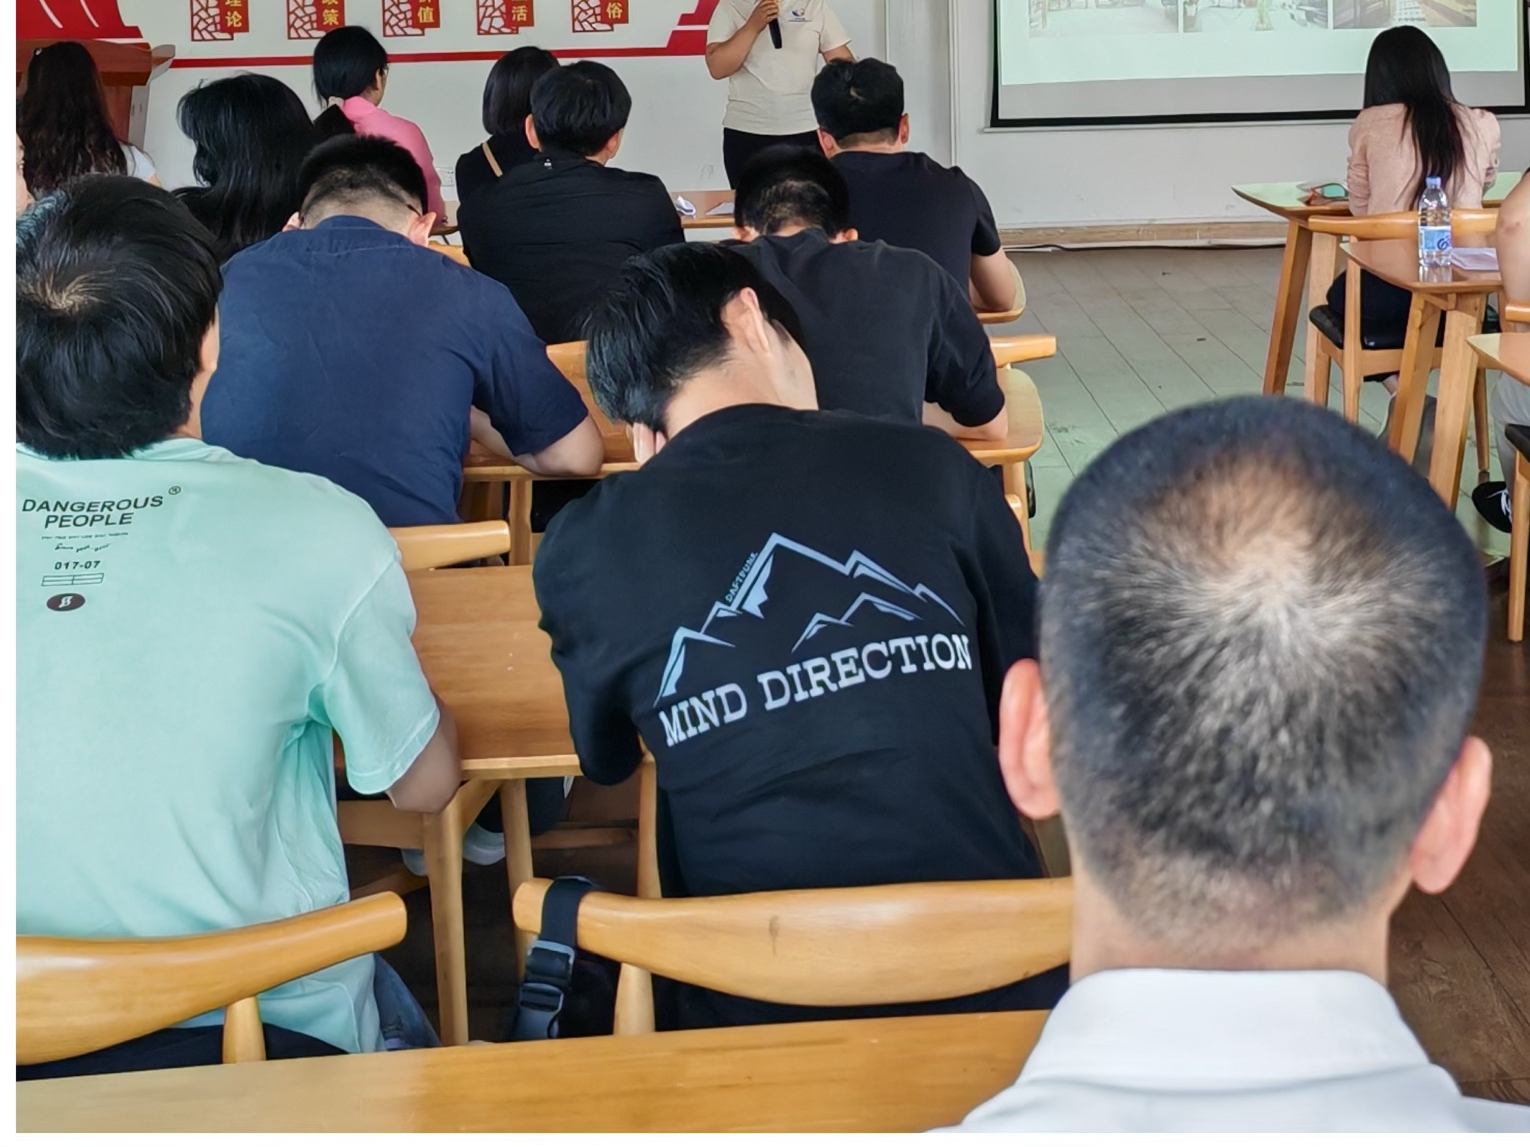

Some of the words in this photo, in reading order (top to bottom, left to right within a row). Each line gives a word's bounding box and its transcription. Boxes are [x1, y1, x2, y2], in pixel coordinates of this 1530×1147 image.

[22, 495, 164, 512] DANGEROUS
[44, 512, 135, 529] PEOPLE
[54, 560, 101, 571] 017-07
[658, 683, 748, 748] MIND
[756, 633, 973, 712] DIRECTION
